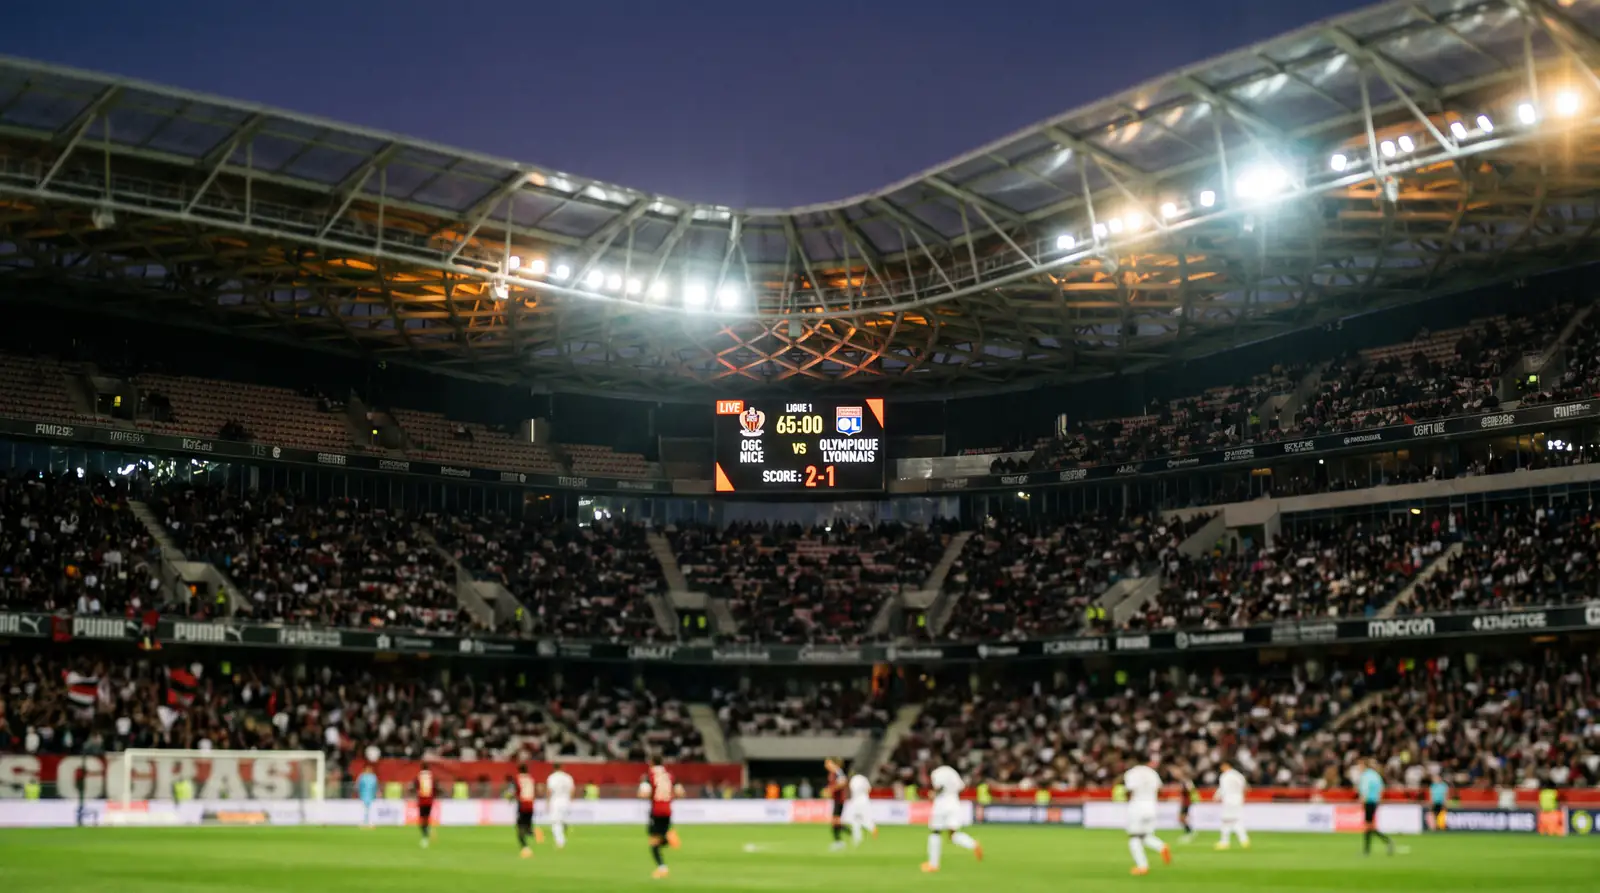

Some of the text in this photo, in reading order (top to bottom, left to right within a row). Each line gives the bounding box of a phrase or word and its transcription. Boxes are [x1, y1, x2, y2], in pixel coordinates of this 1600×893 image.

[719, 402, 740, 413] LIVE
[786, 403, 813, 412] LIGUE 1
[776, 415, 823, 434] 65:00
[838, 417, 861, 431] OL
[741, 439, 763, 452] OGC
[792, 443, 807, 455] VS
[819, 438, 879, 451] OLYMPIQUE
[739, 451, 765, 463] NICE
[823, 450, 875, 463] LYONNAIS
[762, 465, 835, 487] SCORE: 2-1
[73, 616, 125, 637] PUMA
[174, 622, 225, 642] PUMA
[1368, 618, 1435, 638] macron
